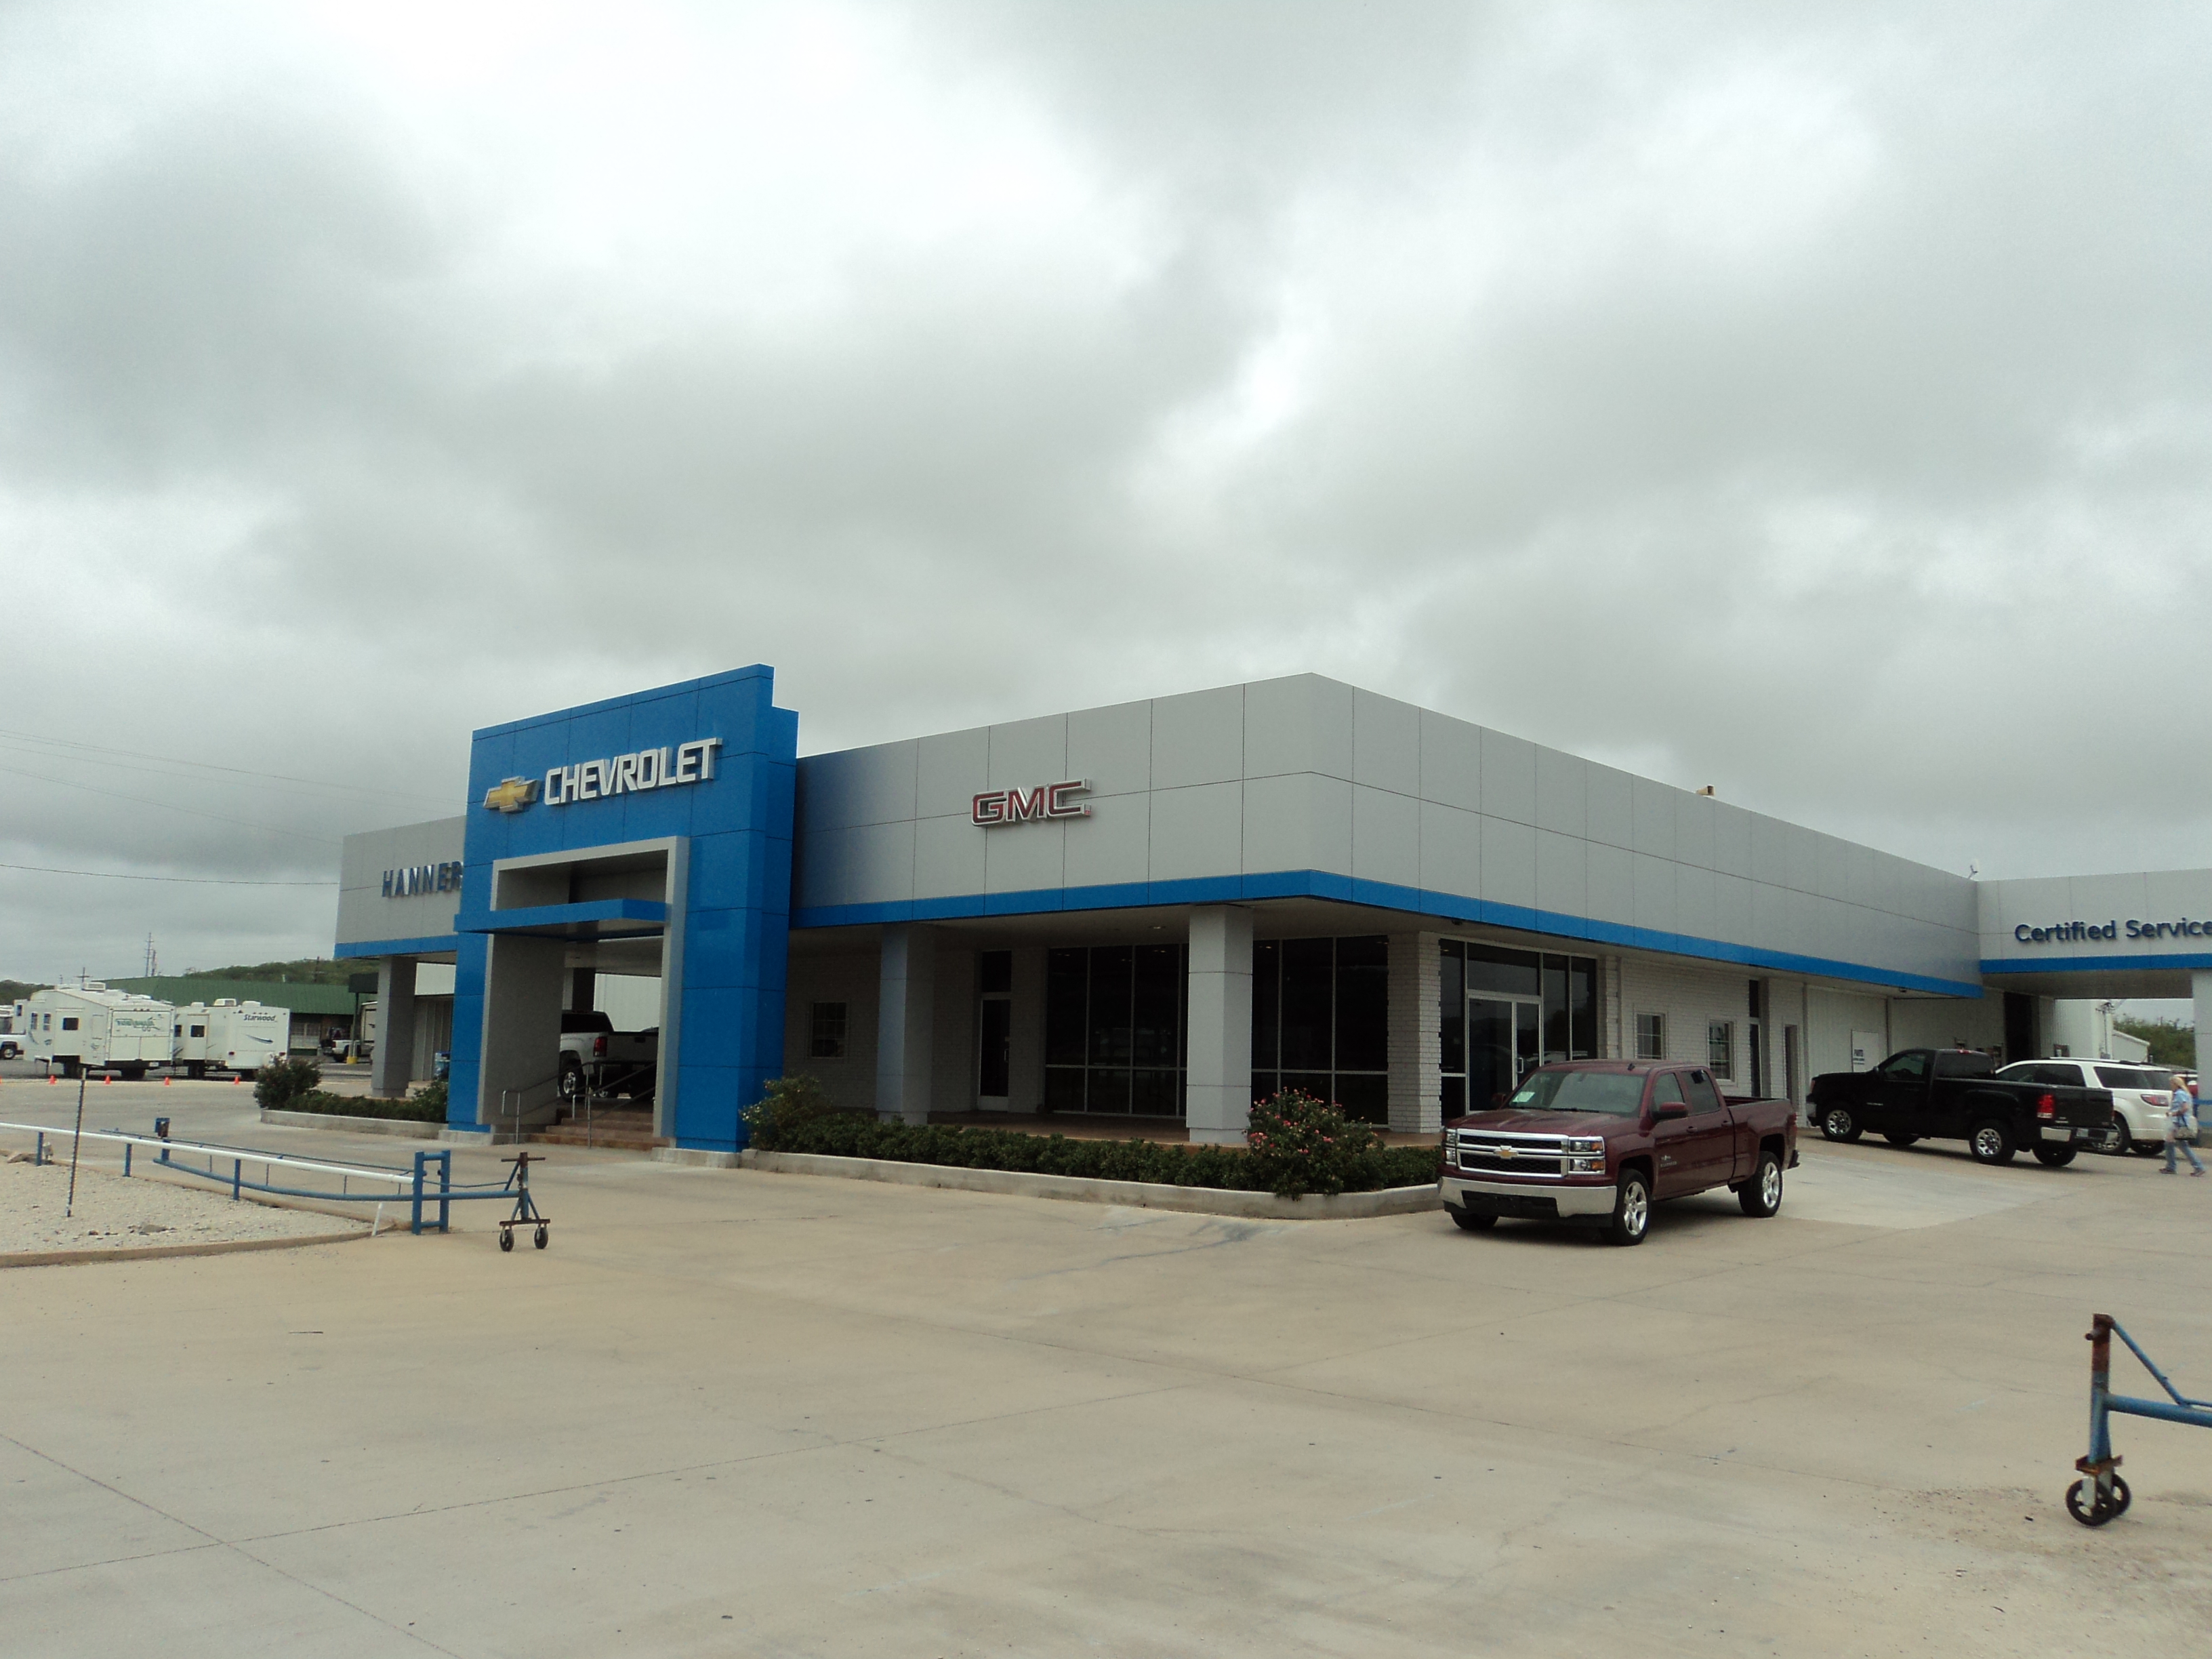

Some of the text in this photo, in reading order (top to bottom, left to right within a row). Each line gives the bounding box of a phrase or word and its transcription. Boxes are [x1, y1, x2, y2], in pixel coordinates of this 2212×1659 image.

[544, 737, 722, 805] CHEVROLET
[971, 779, 1092, 826] GMC
[382, 860, 464, 898] HANNER
[2014, 917, 2212, 943] Certified Service
